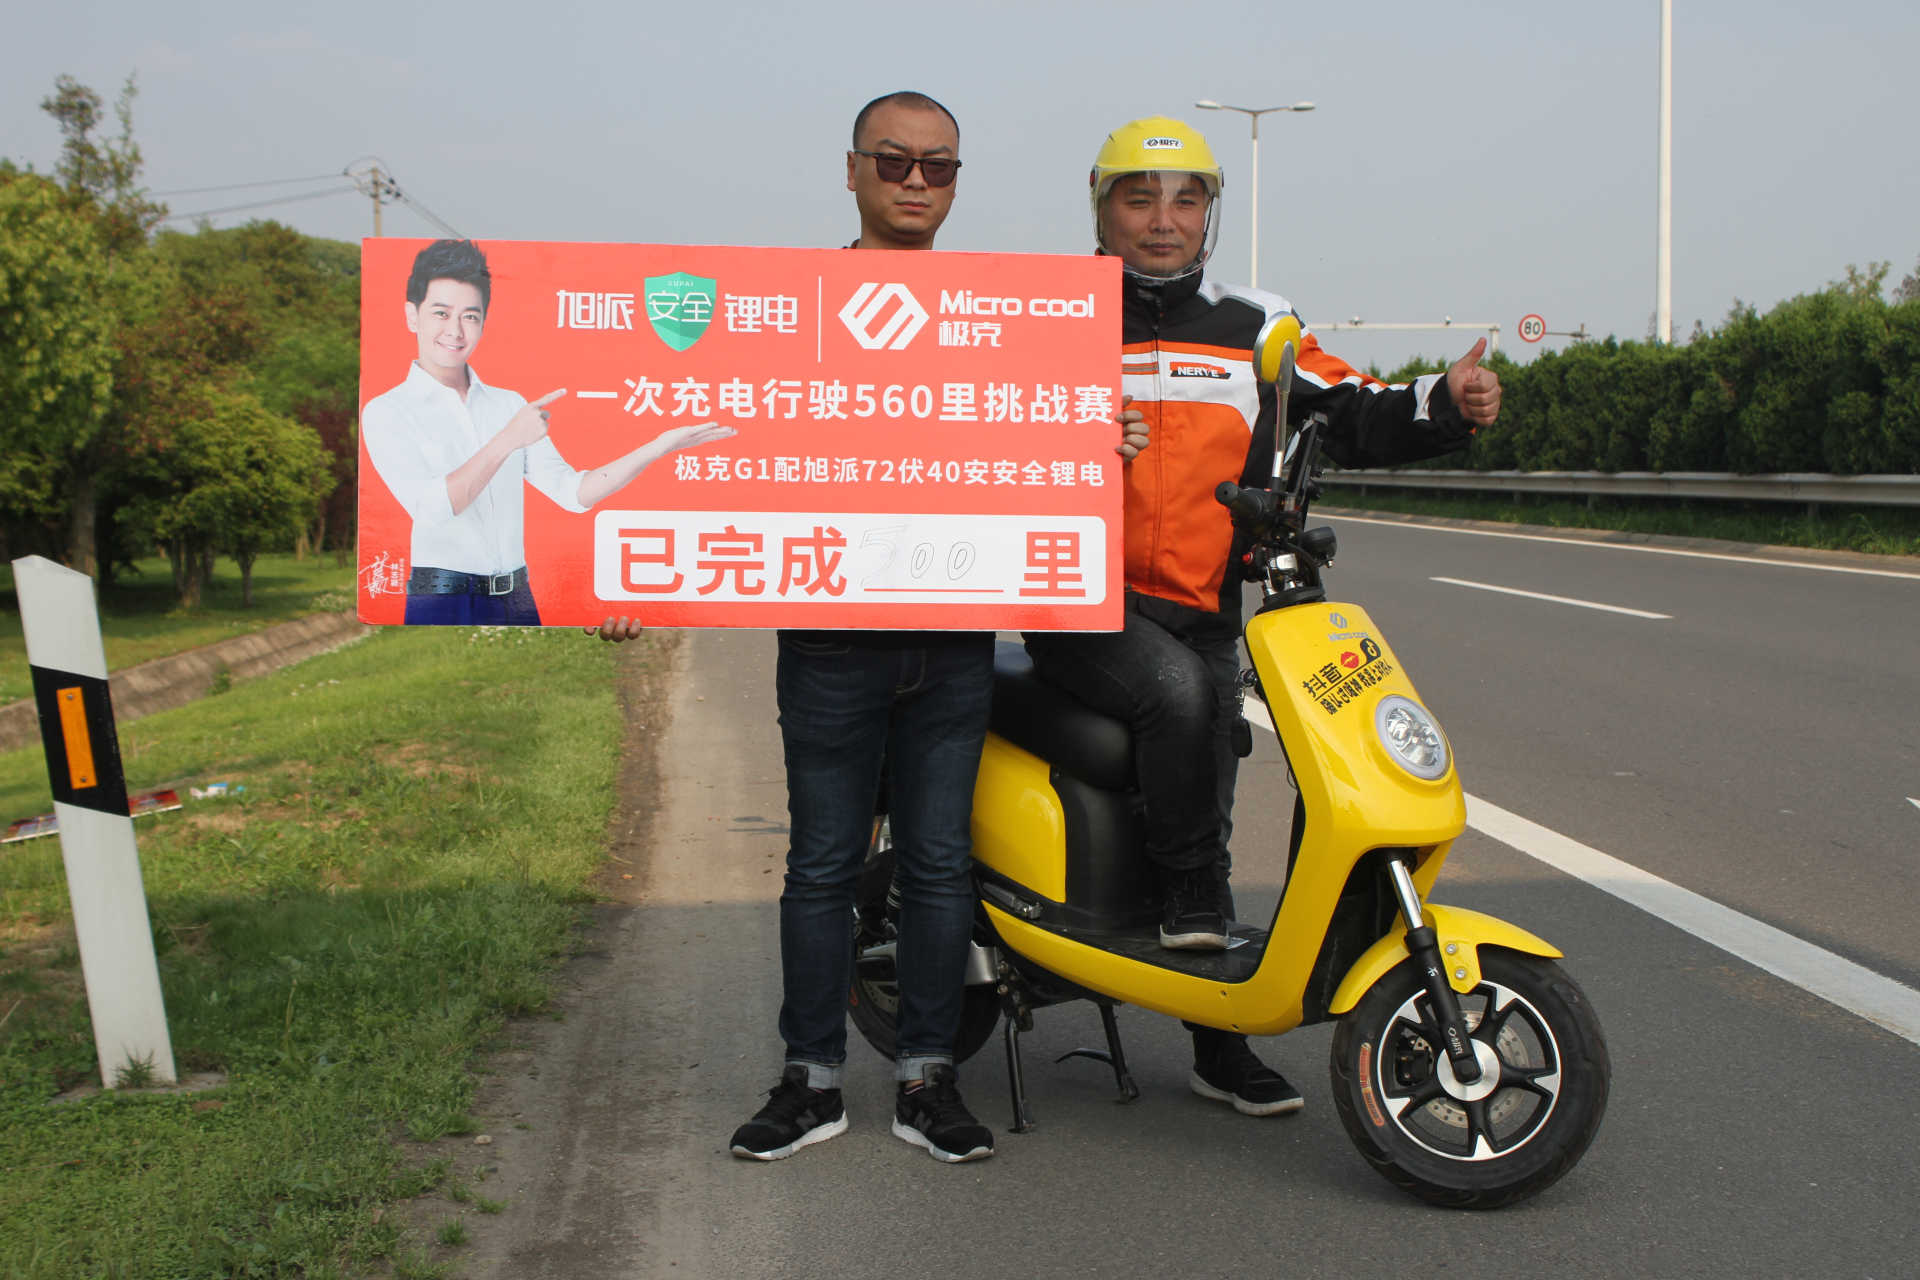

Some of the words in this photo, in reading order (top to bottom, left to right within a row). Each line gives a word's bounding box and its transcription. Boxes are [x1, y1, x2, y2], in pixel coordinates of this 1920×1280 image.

[556, 290, 634, 330] 旭派
[648, 290, 712, 322] 安全
[724, 293, 798, 333] 锂电
[939, 289, 1022, 316] Micro
[1029, 293, 1095, 318] cool
[938, 320, 1002, 348] 极克
[1524, 321, 1541, 335] 80
[576, 376, 1113, 425] 一次充电行驶560里挑战赛
[675, 454, 1105, 487] 极克G1配旭派72伏40安安全锂电
[618, 525, 847, 597] 已完成
[858, 525, 977, 589] 500
[1018, 531, 1087, 598] 里
[1302, 662, 1343, 698] 抖音
